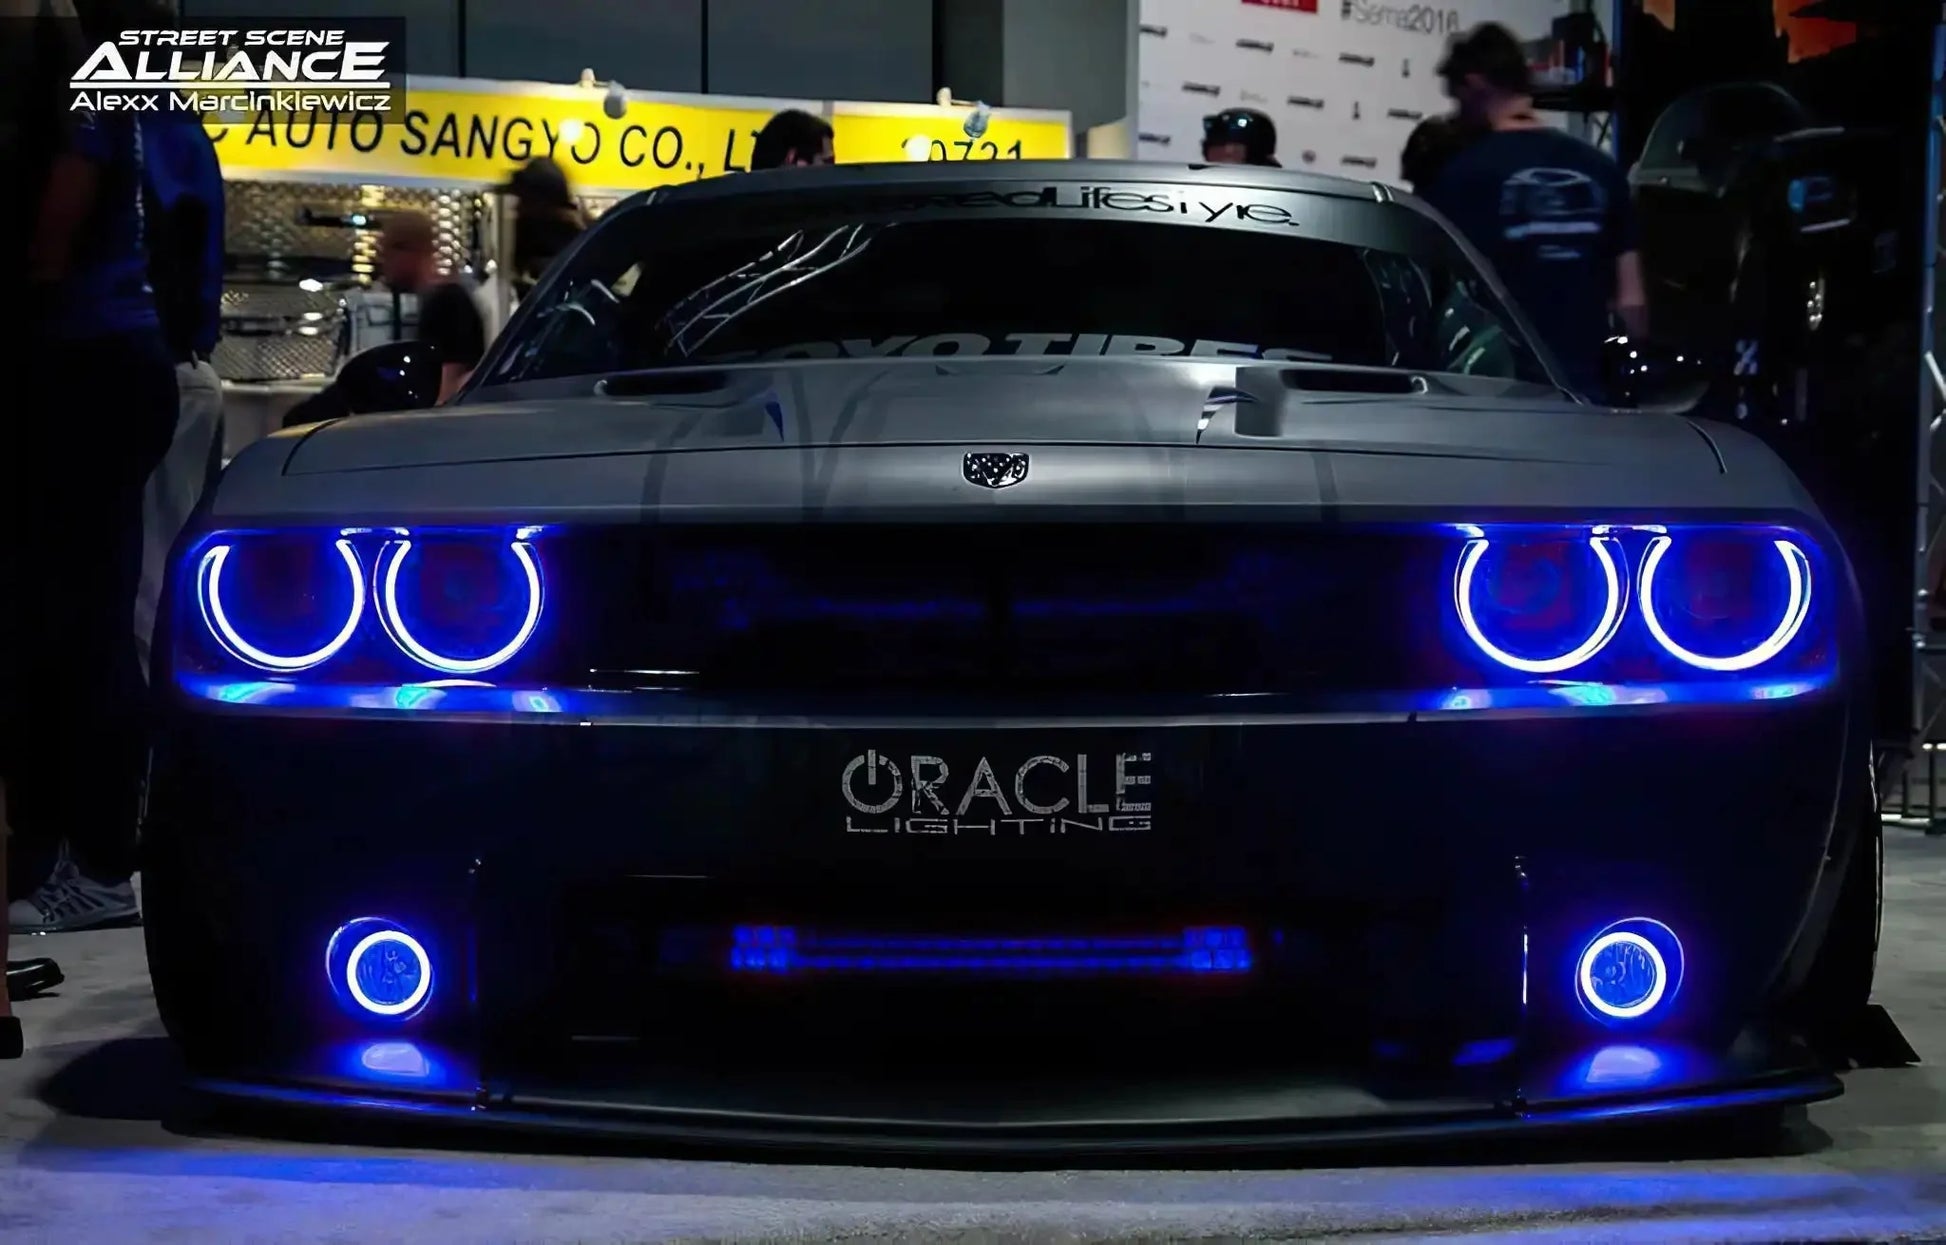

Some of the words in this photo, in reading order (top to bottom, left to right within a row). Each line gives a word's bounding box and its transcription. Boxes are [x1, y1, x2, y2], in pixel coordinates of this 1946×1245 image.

[245, 104, 384, 152] AUTO
[400, 110, 601, 165] SANGYO
[901, 138, 1022, 161] 0721
[842, 749, 1151, 815] ORACLE
